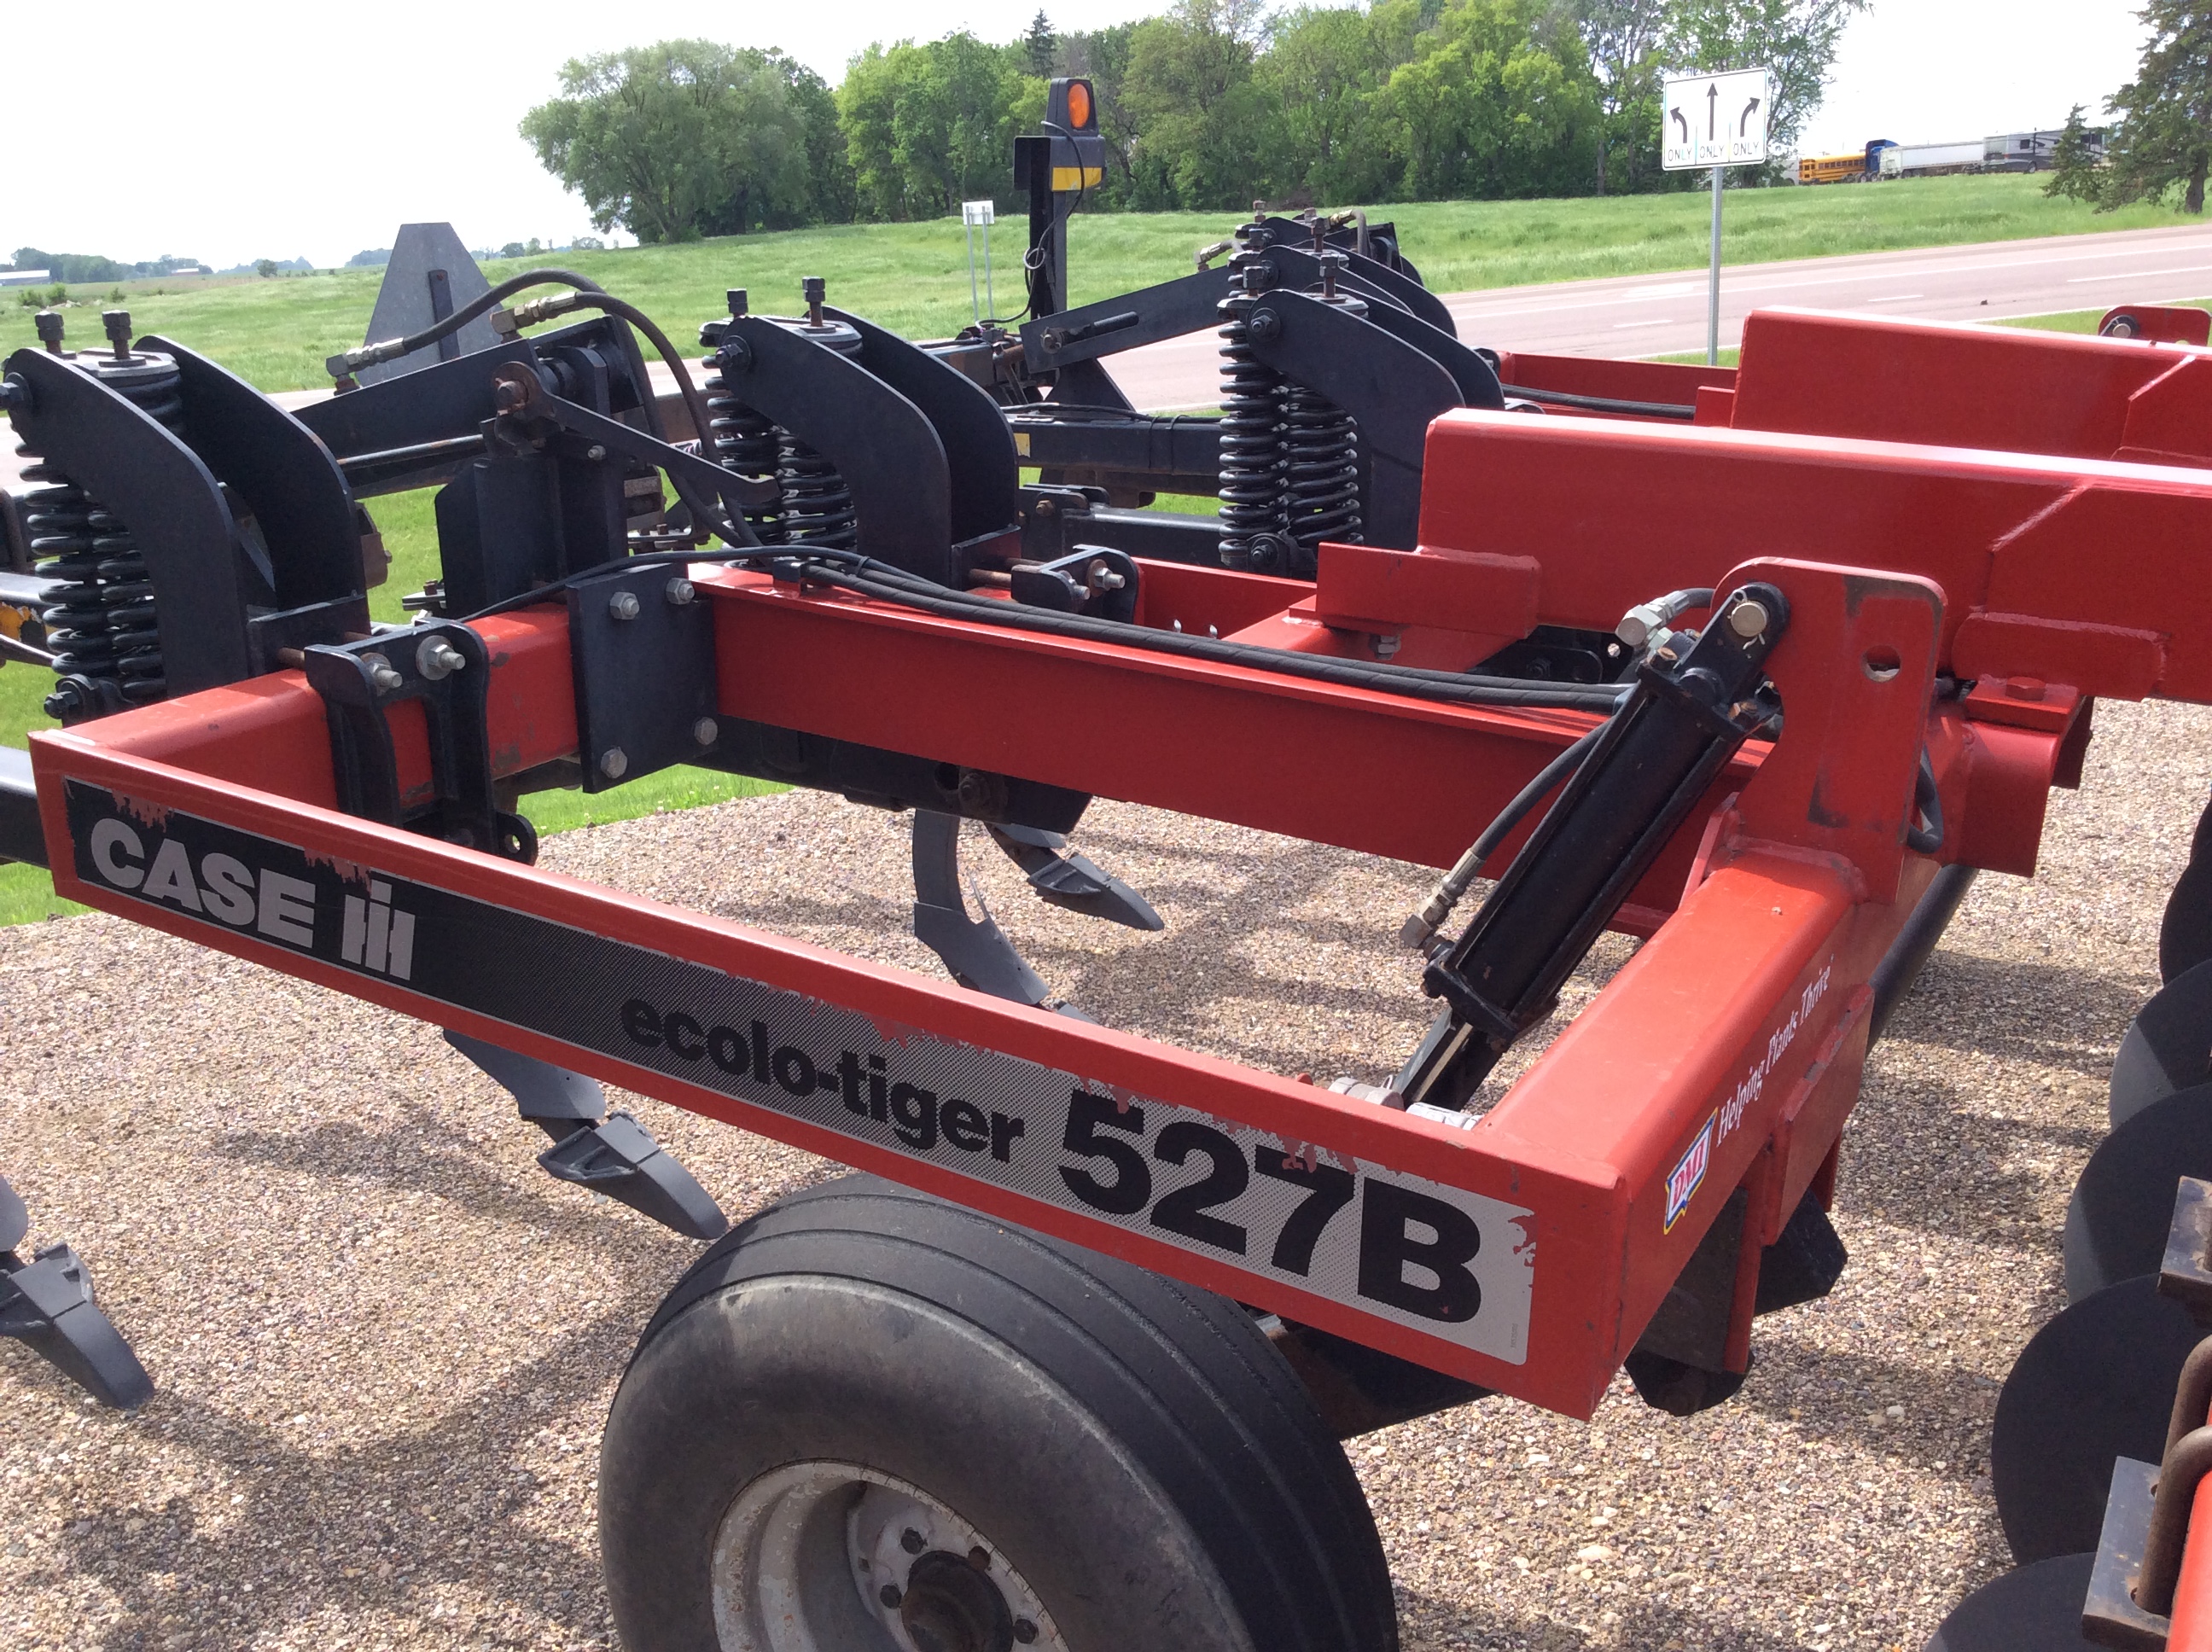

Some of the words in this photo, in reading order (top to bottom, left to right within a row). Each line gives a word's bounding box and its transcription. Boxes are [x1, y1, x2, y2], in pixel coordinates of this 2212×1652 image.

[1668, 148, 1692, 161] ONLY
[1699, 144, 1724, 159] ONLY
[1732, 142, 1759, 156] ONLY
[90, 817, 317, 949] CASE
[1716, 1060, 1766, 1148] Helping
[1766, 1009, 1798, 1075] Plants
[620, 997, 1024, 1163] ecolo-tiger
[1058, 1089, 1481, 1323] 527B
[1671, 1137, 1706, 1212] DMI
